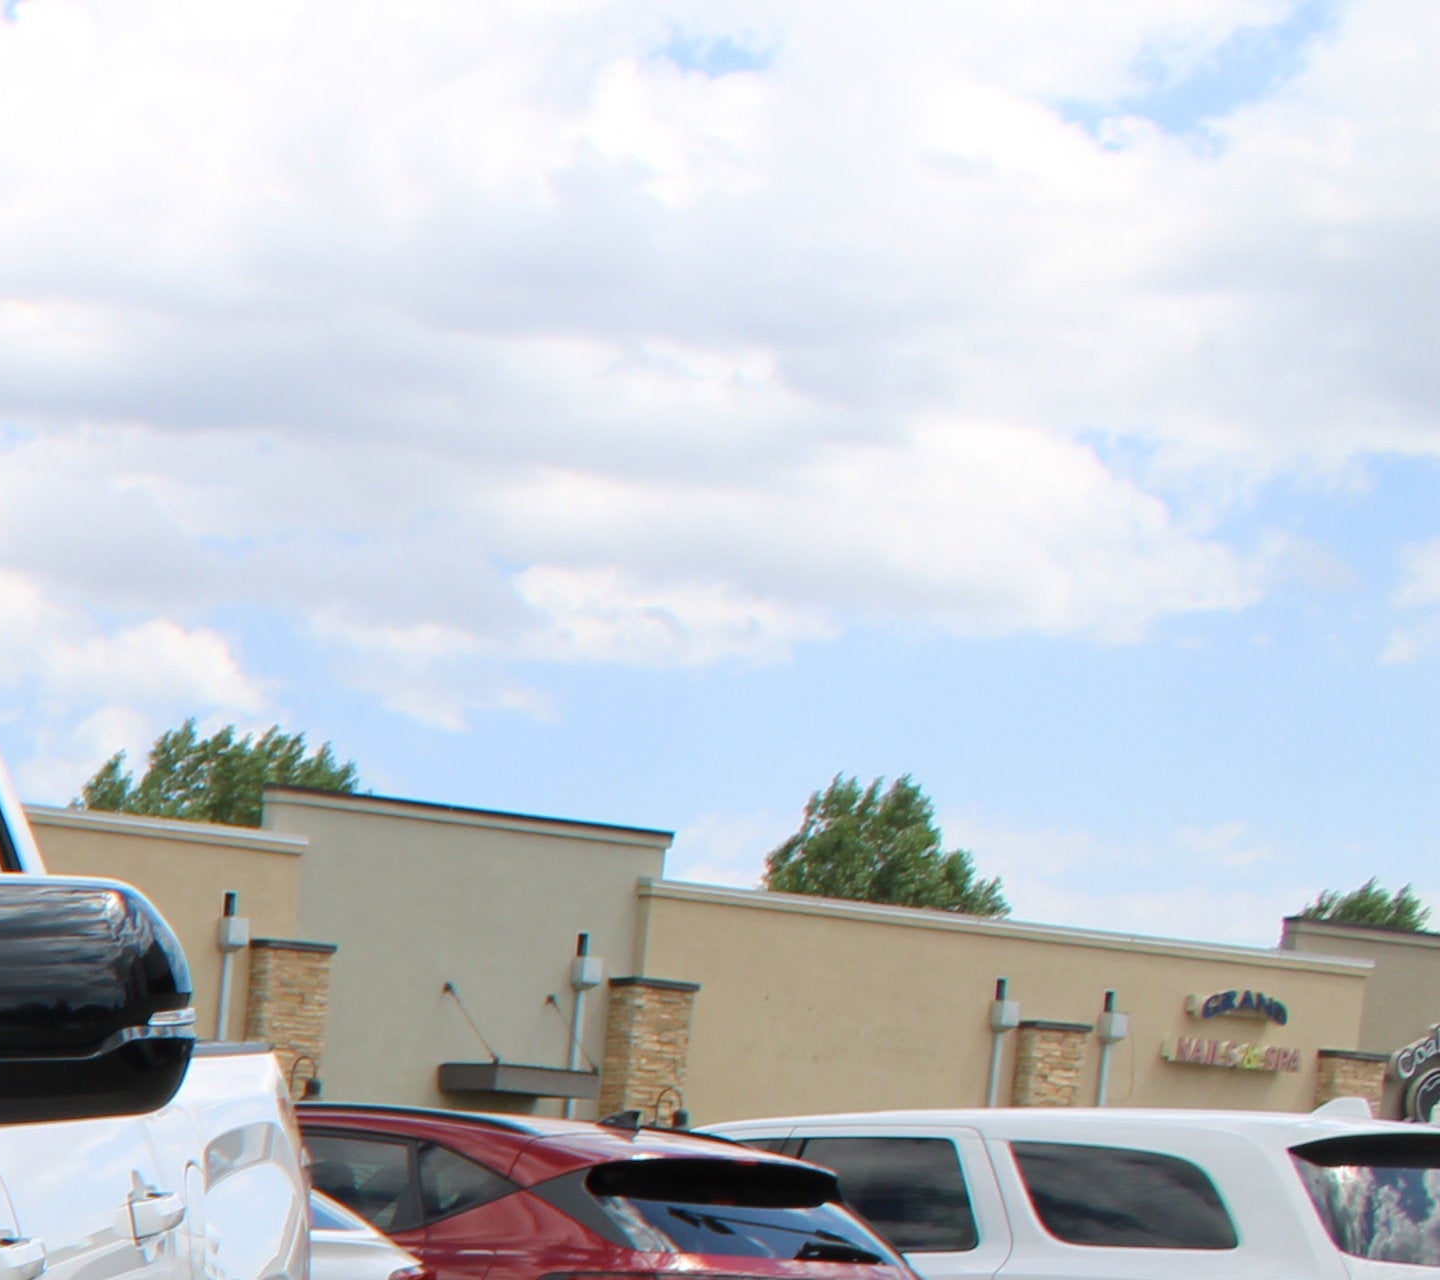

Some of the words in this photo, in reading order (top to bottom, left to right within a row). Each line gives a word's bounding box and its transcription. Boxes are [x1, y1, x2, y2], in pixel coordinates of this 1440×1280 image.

[1202, 990, 1288, 1026] GRAND
[1178, 1037, 1239, 1067] NAILS
[1264, 1046, 1302, 1072] SPA
